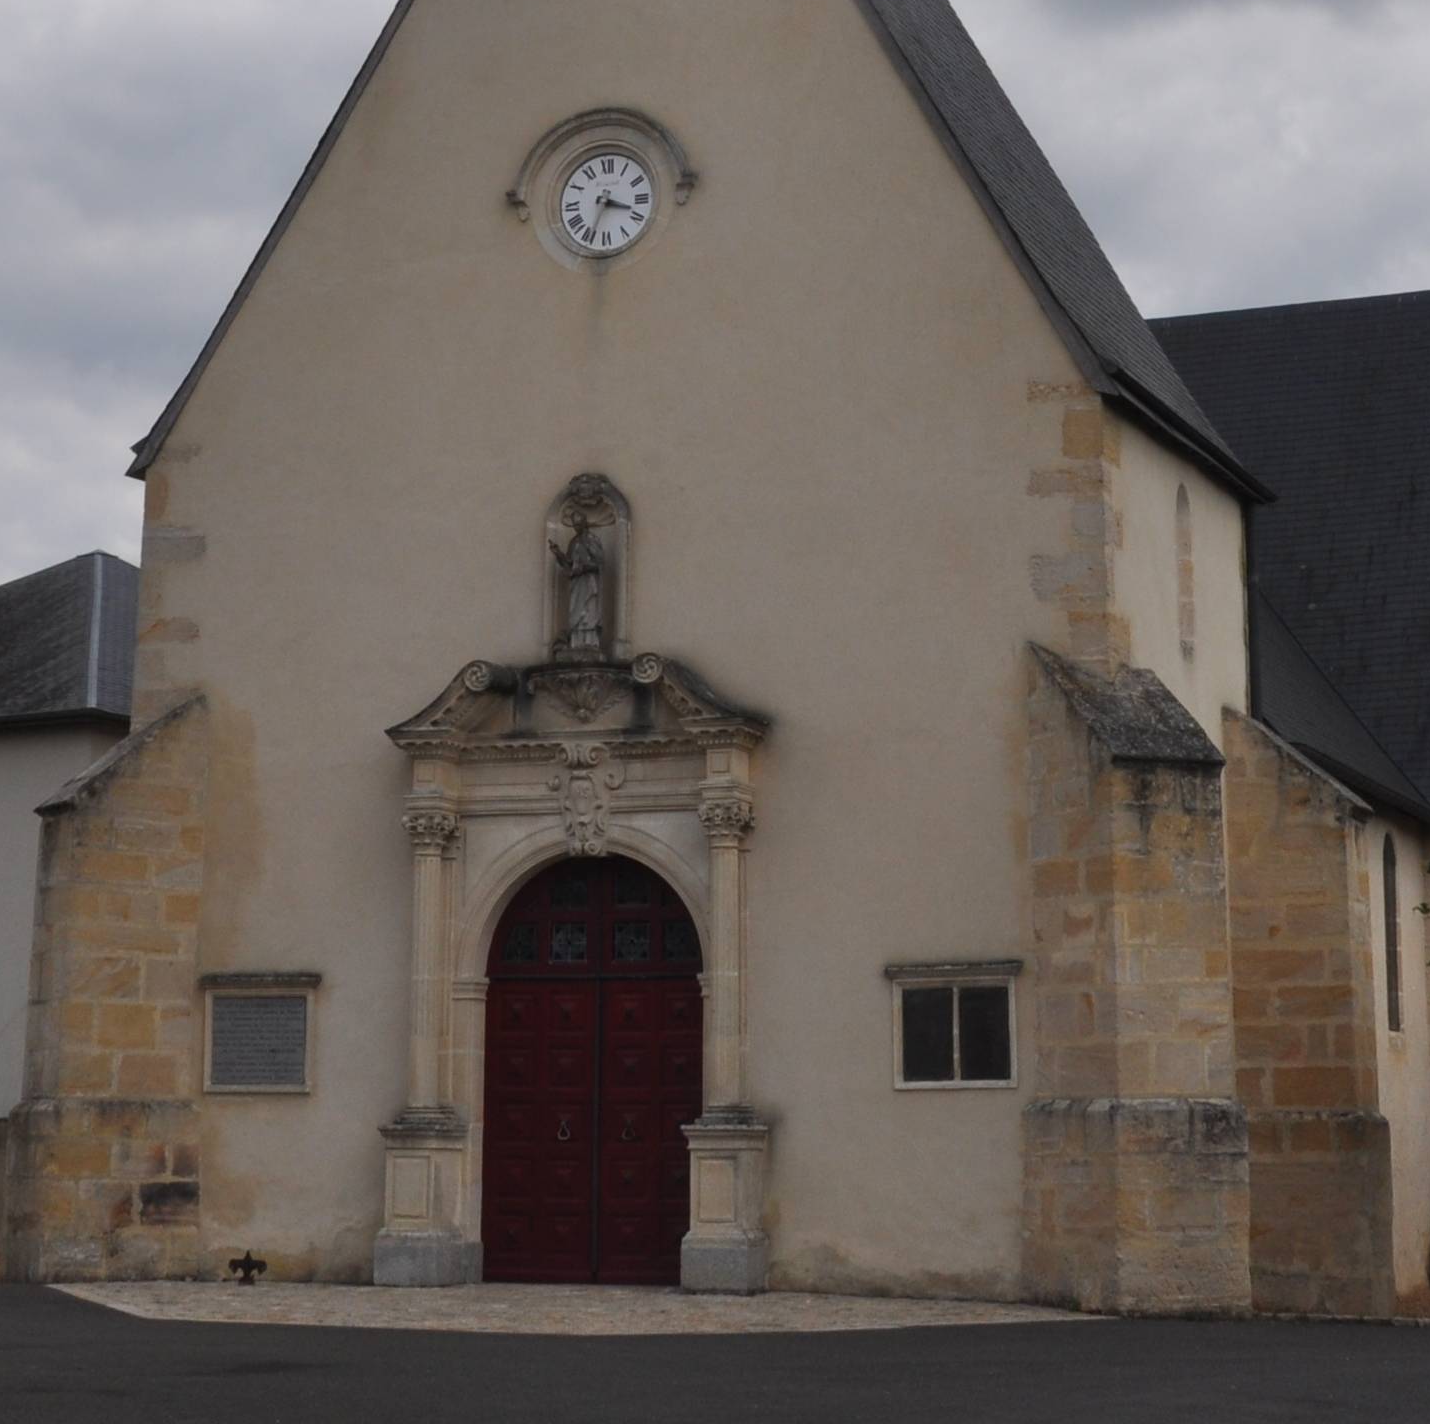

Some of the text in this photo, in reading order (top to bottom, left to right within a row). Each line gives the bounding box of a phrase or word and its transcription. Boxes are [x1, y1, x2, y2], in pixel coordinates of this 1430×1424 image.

[582, 165, 596, 180] XI
[601, 159, 614, 174] XII
[620, 162, 629, 176] I
[570, 183, 584, 193] X
[630, 175, 644, 188] II
[635, 193, 649, 204] III
[565, 201, 579, 212] IX
[620, 225, 630, 238] V
[602, 231, 612, 246] VI
